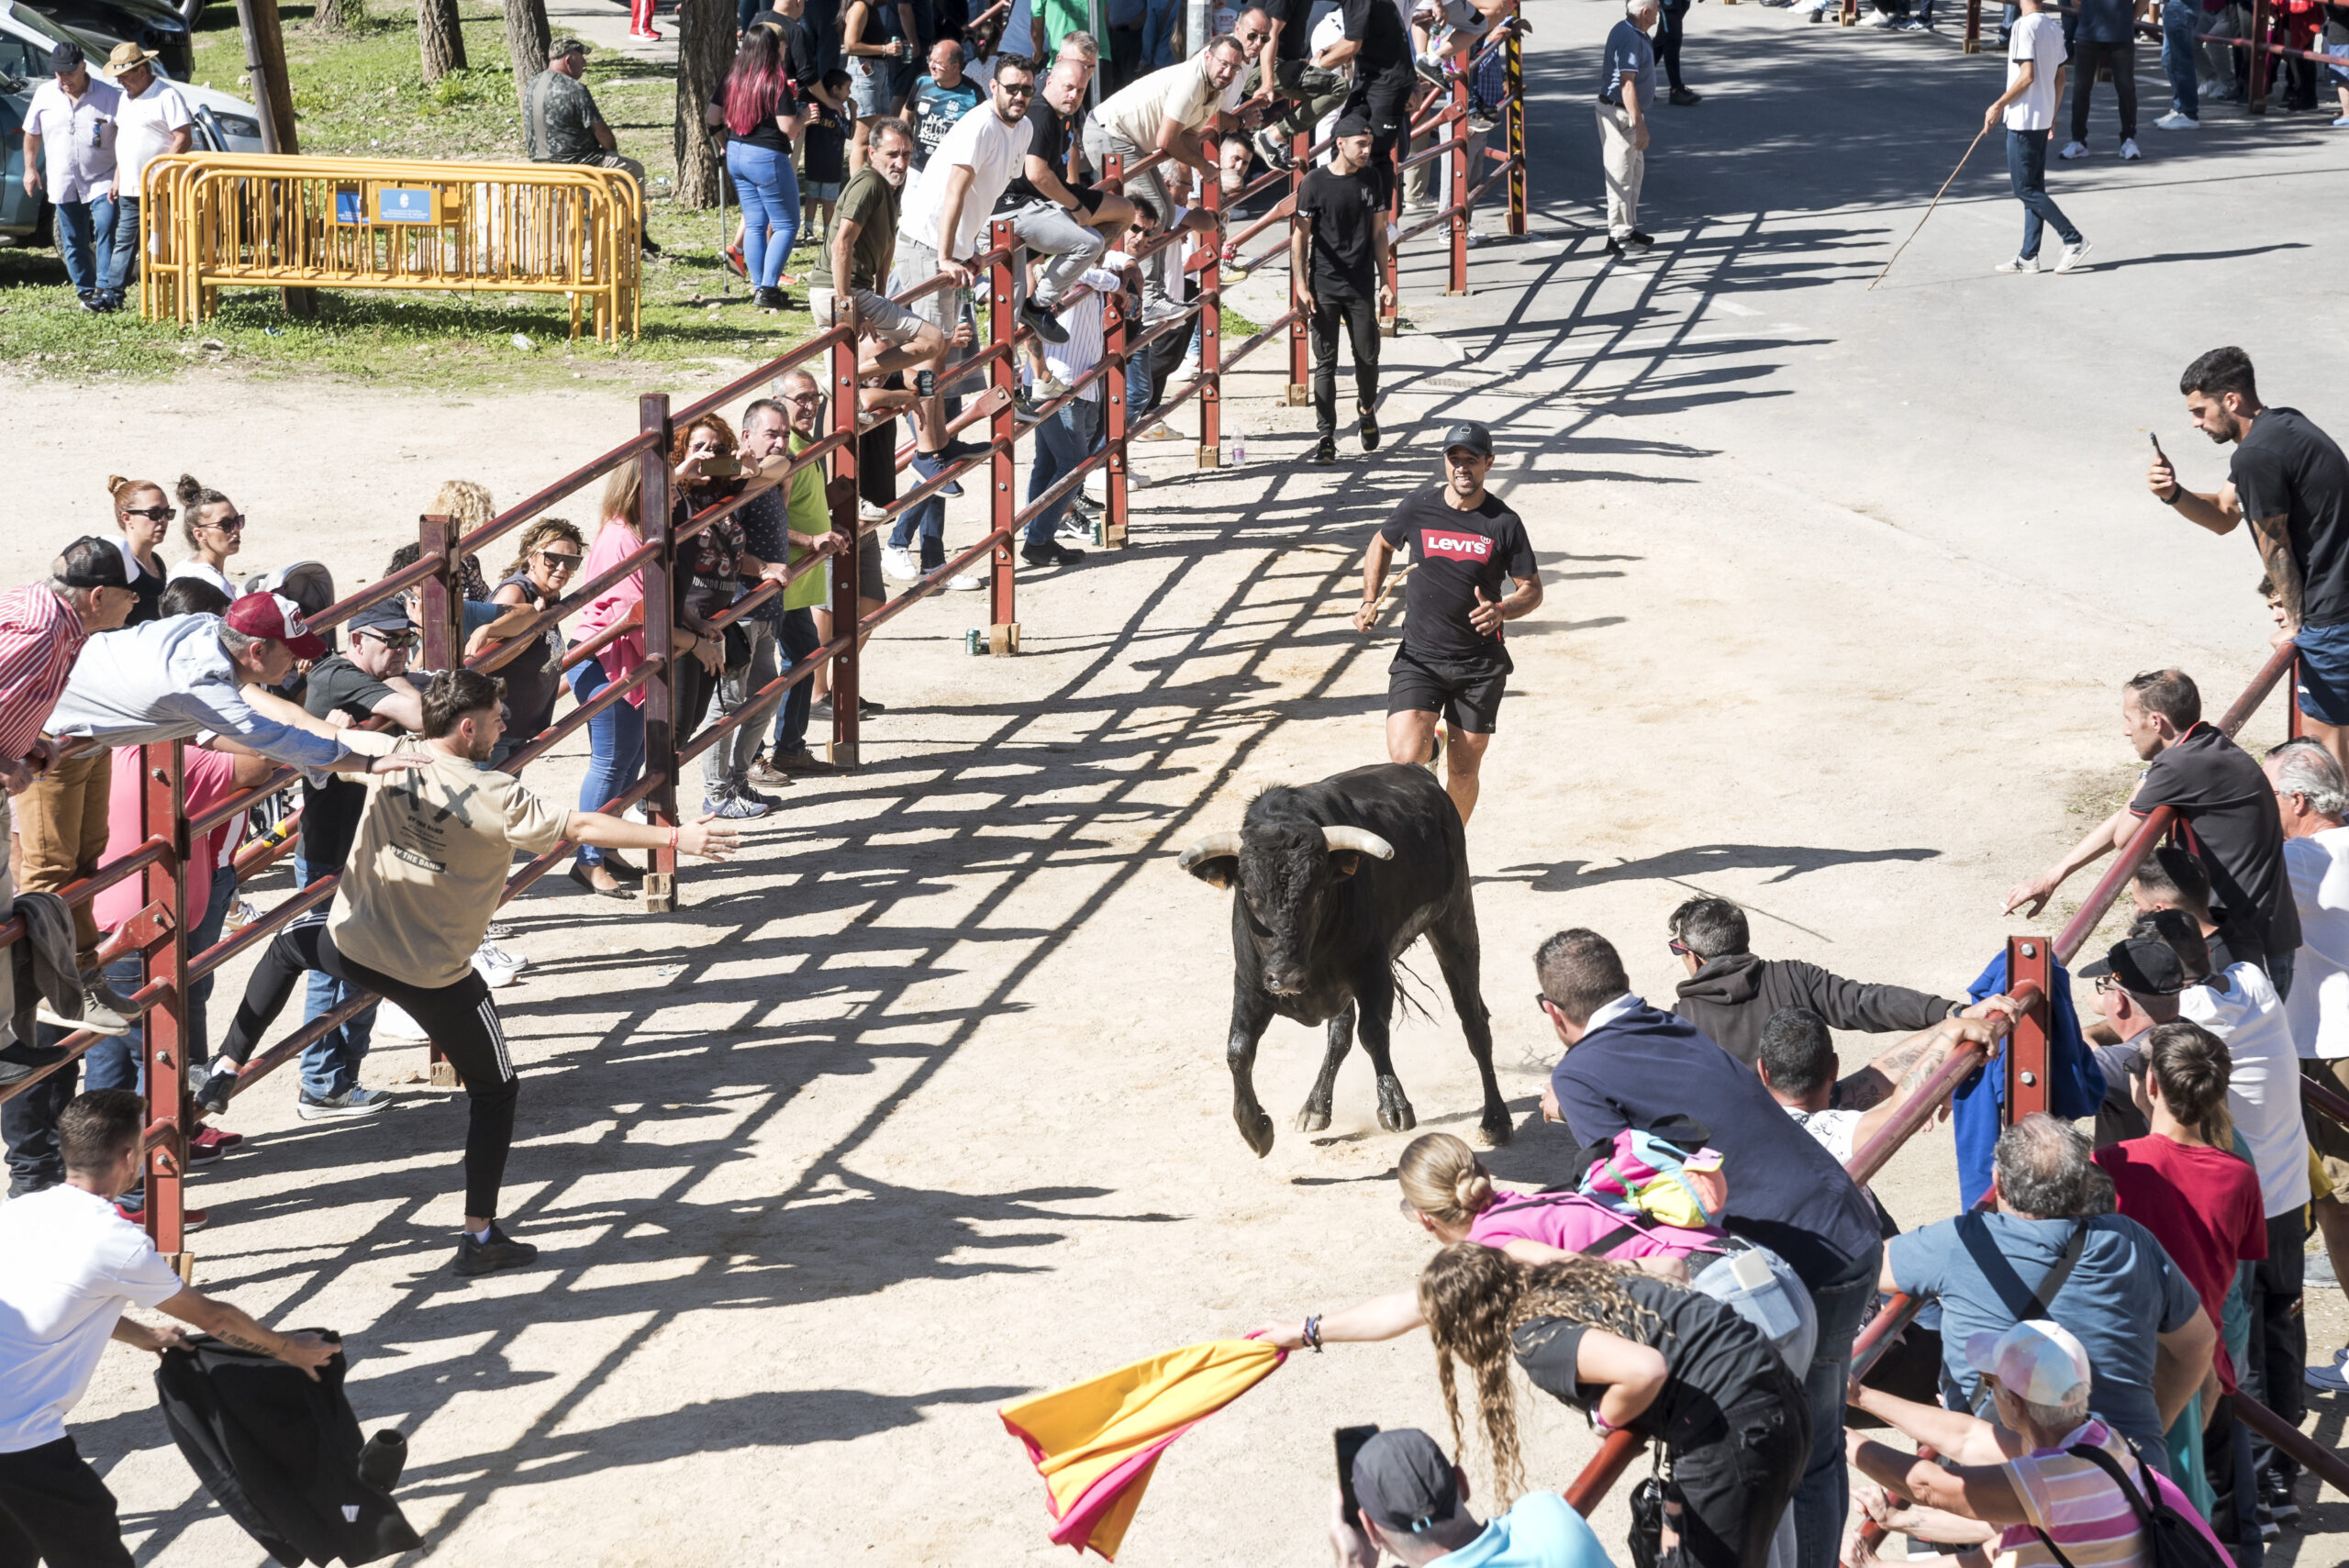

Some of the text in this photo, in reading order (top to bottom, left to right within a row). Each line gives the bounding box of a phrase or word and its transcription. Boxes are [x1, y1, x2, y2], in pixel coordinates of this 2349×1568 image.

[1428, 536, 1486, 555] Levi's
[391, 845, 441, 871] BY THE BAND
